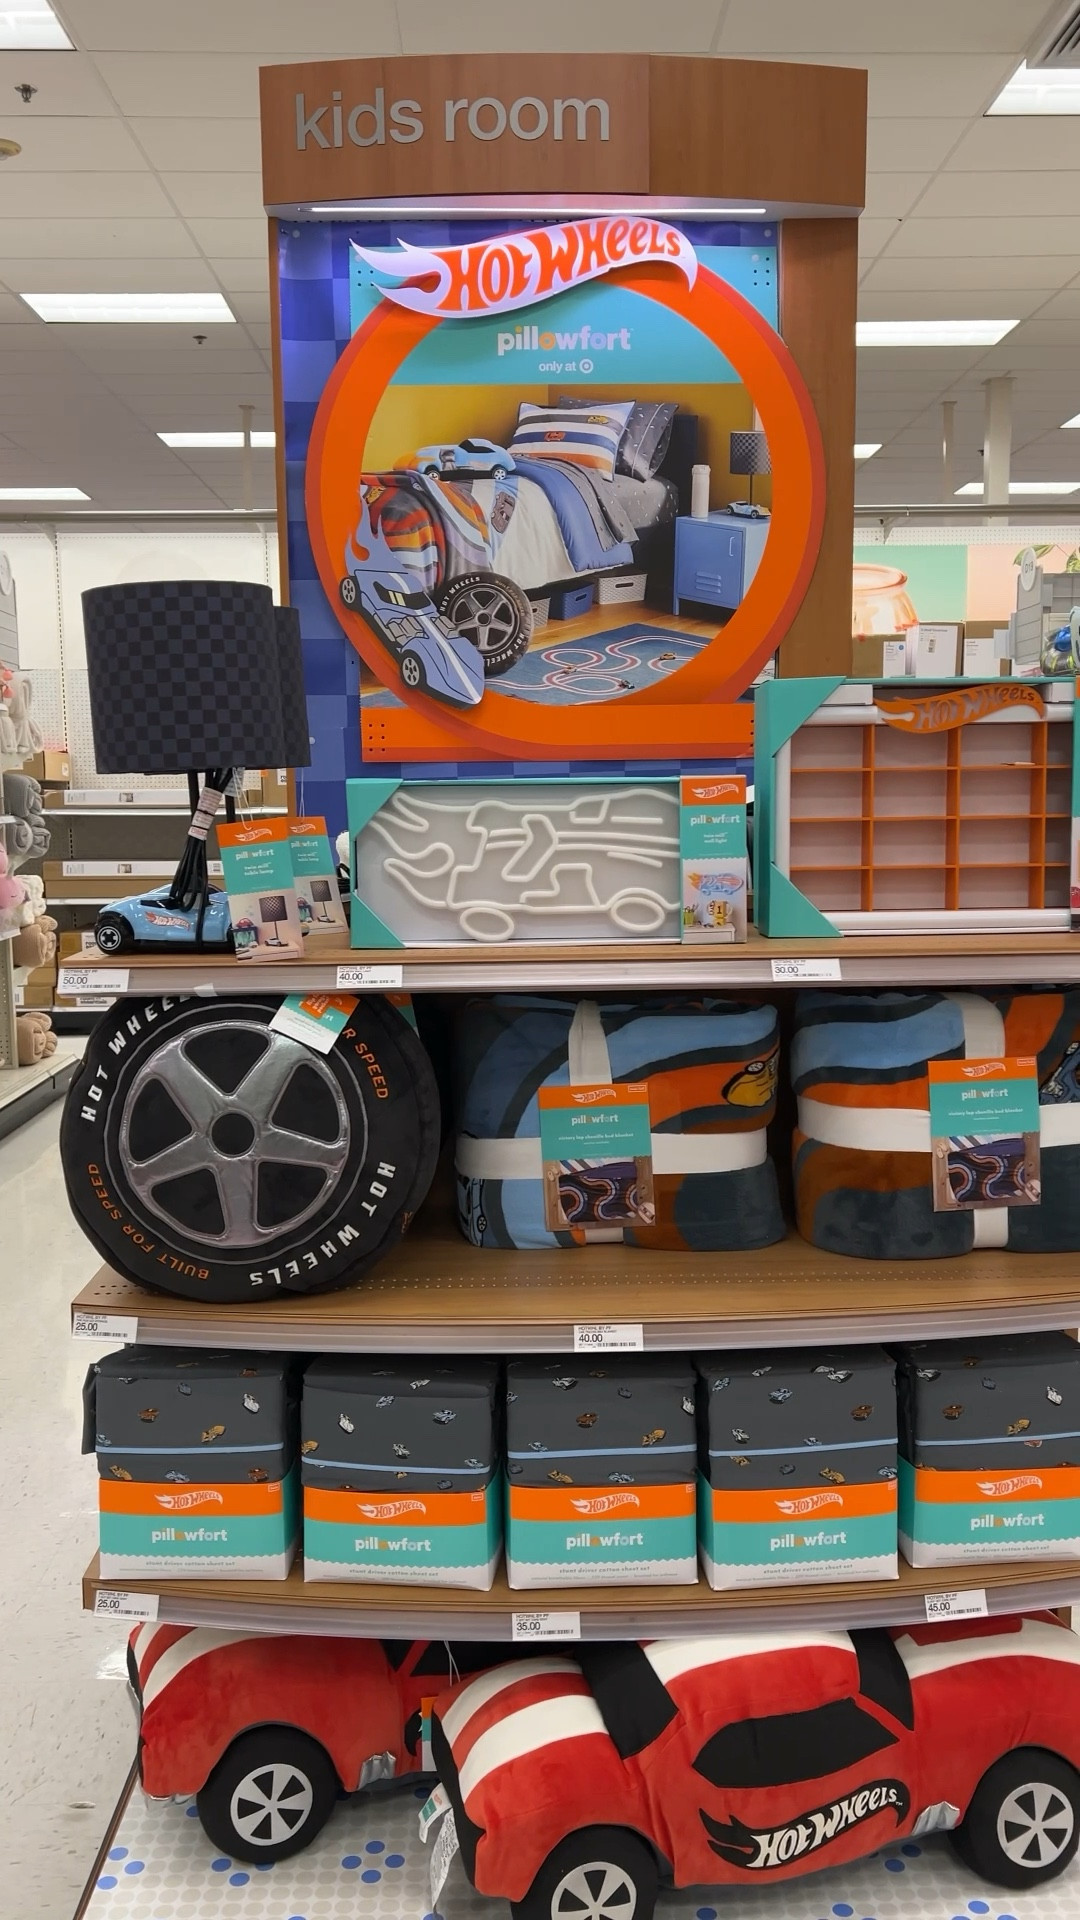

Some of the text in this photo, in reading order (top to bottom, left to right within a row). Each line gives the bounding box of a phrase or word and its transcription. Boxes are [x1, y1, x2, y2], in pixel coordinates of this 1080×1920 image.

[295, 87, 610, 150] kids room
[497, 325, 632, 356] pillowfort
[538, 359, 576, 372] only at
[690, 814, 740, 827] pillowfort
[235, 849, 274, 861] pillowfort
[355, 1043, 388, 1098] SPEED
[81, 1065, 108, 1122] HOT
[961, 1088, 1009, 1101] pillowfort
[571, 1114, 619, 1126] pillowfort
[88, 1163, 209, 1280] BUILT FOR SPEED
[250, 1161, 396, 1286] HOT WHEELS
[75, 1322, 98, 1331] 25.00
[579, 1334, 603, 1342] 40.00
[970, 1512, 1045, 1531] pillowfort
[151, 1527, 228, 1544] pillowfort
[566, 1532, 644, 1550] pillowfort
[770, 1531, 847, 1551] pillowfort
[354, 1536, 432, 1552] pillowfort
[98, 1599, 119, 1608] 25.00
[928, 1602, 950, 1611] 45.00
[516, 1622, 541, 1631] 35.00
